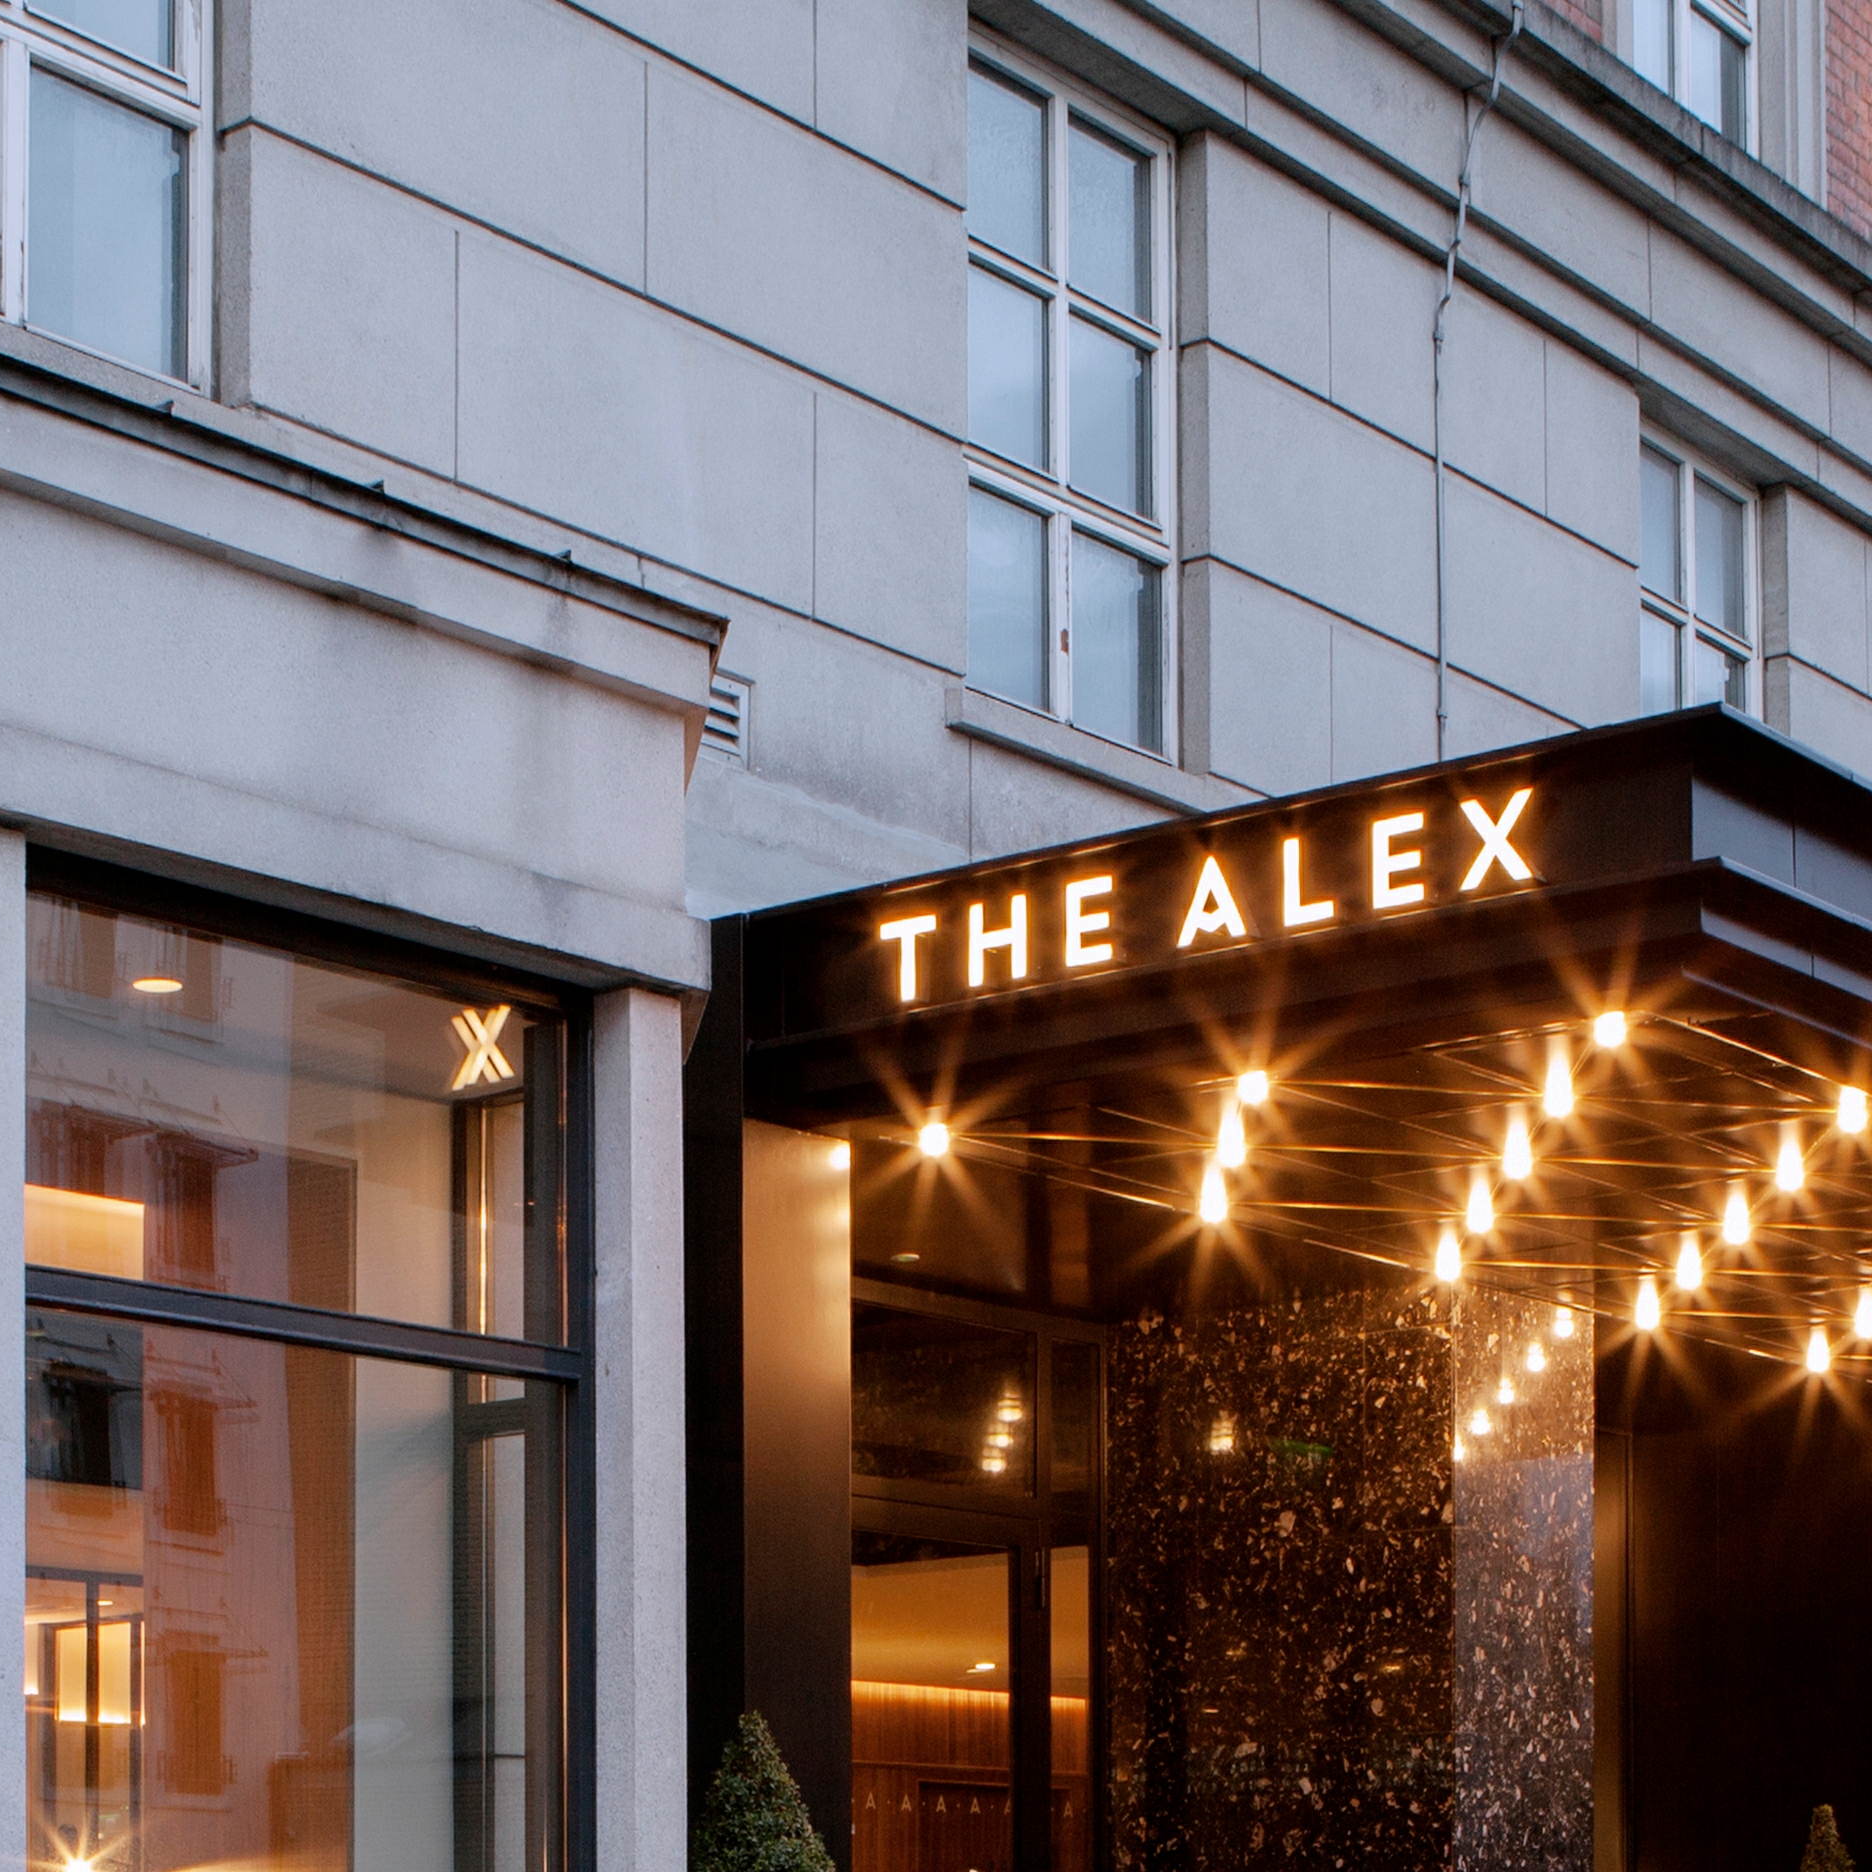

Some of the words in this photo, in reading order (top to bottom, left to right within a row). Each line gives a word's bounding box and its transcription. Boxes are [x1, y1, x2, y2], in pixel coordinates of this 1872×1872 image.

[878, 875, 1114, 1003] THE
[1176, 787, 1533, 950] ALEX
[865, 1791, 877, 1810] A
[901, 1793, 912, 1812] A
[935, 1794, 947, 1813] A
[970, 1796, 981, 1814] A
